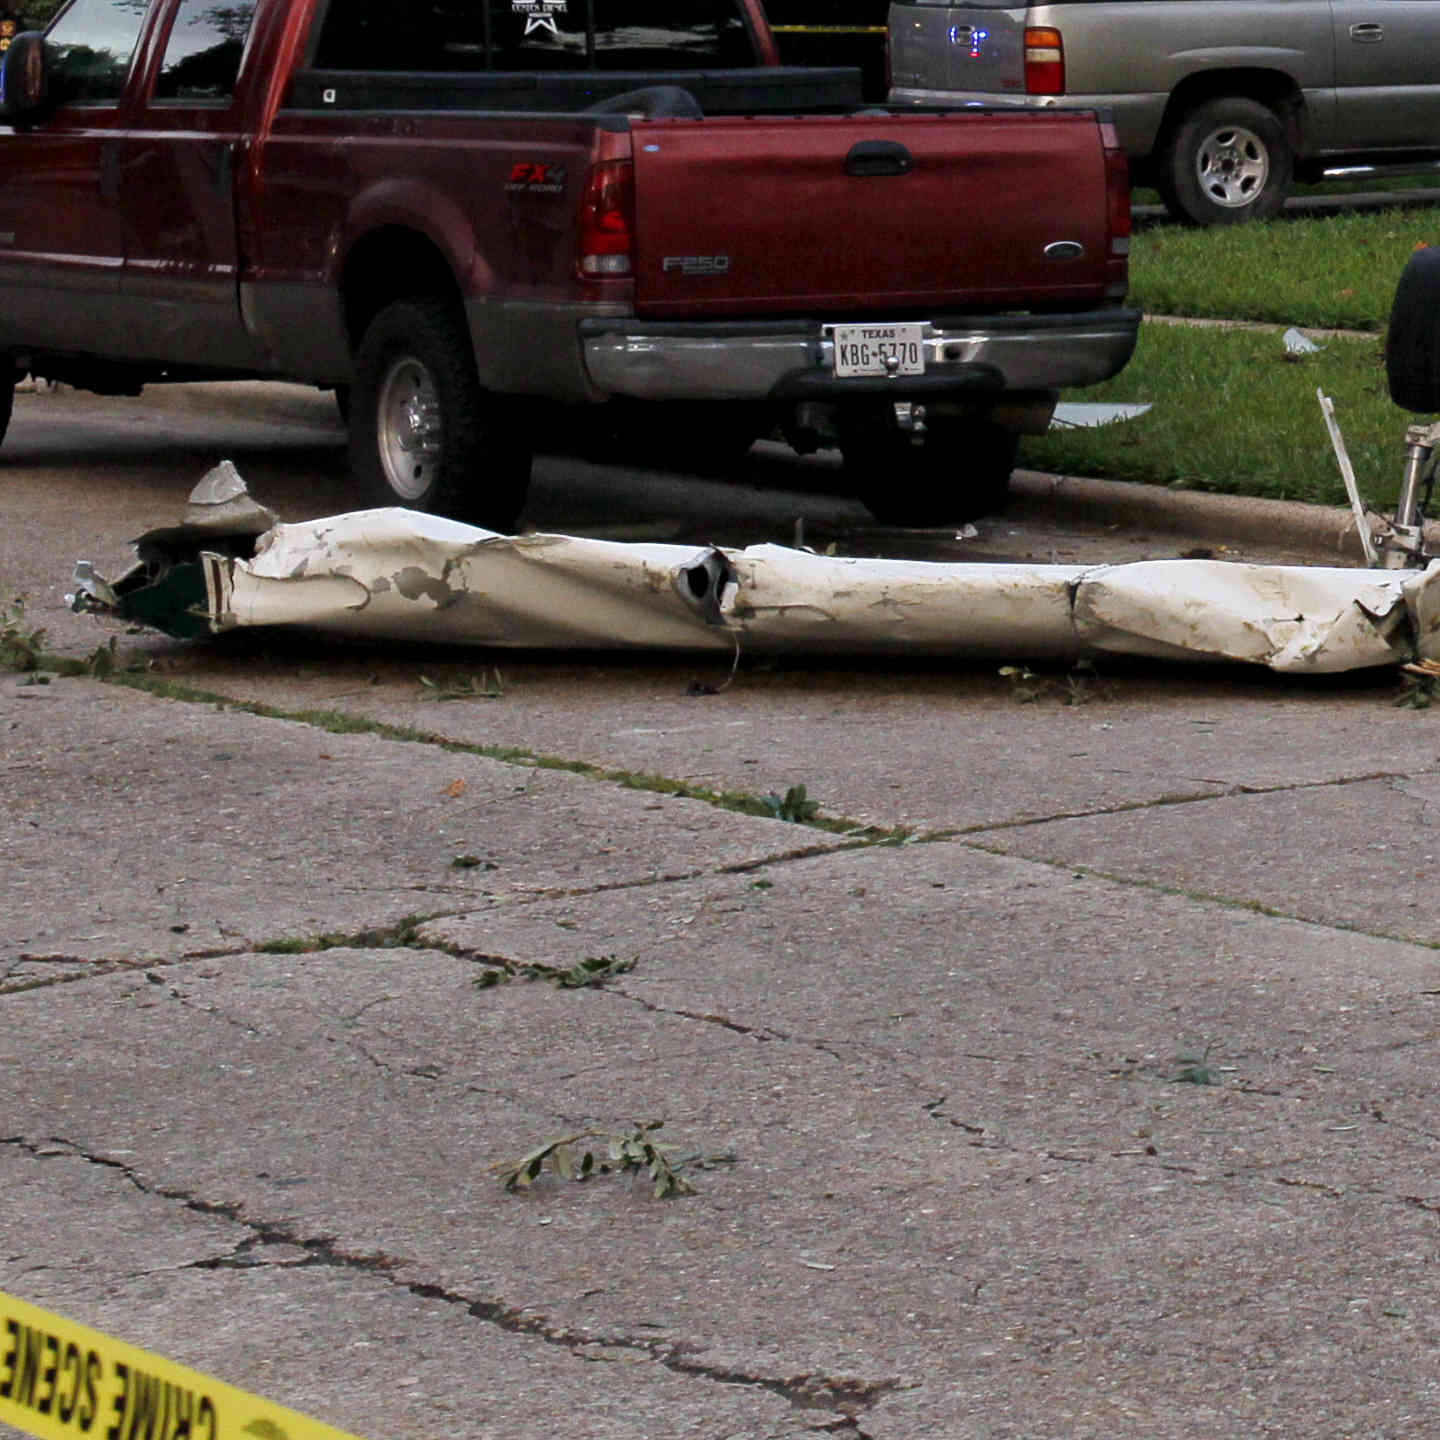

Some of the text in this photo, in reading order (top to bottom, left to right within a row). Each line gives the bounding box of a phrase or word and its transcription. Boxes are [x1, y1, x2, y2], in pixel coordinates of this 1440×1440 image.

[862, 329, 896, 339] TEXAS
[0, 1317, 218, 1440] CRIME SCENE
